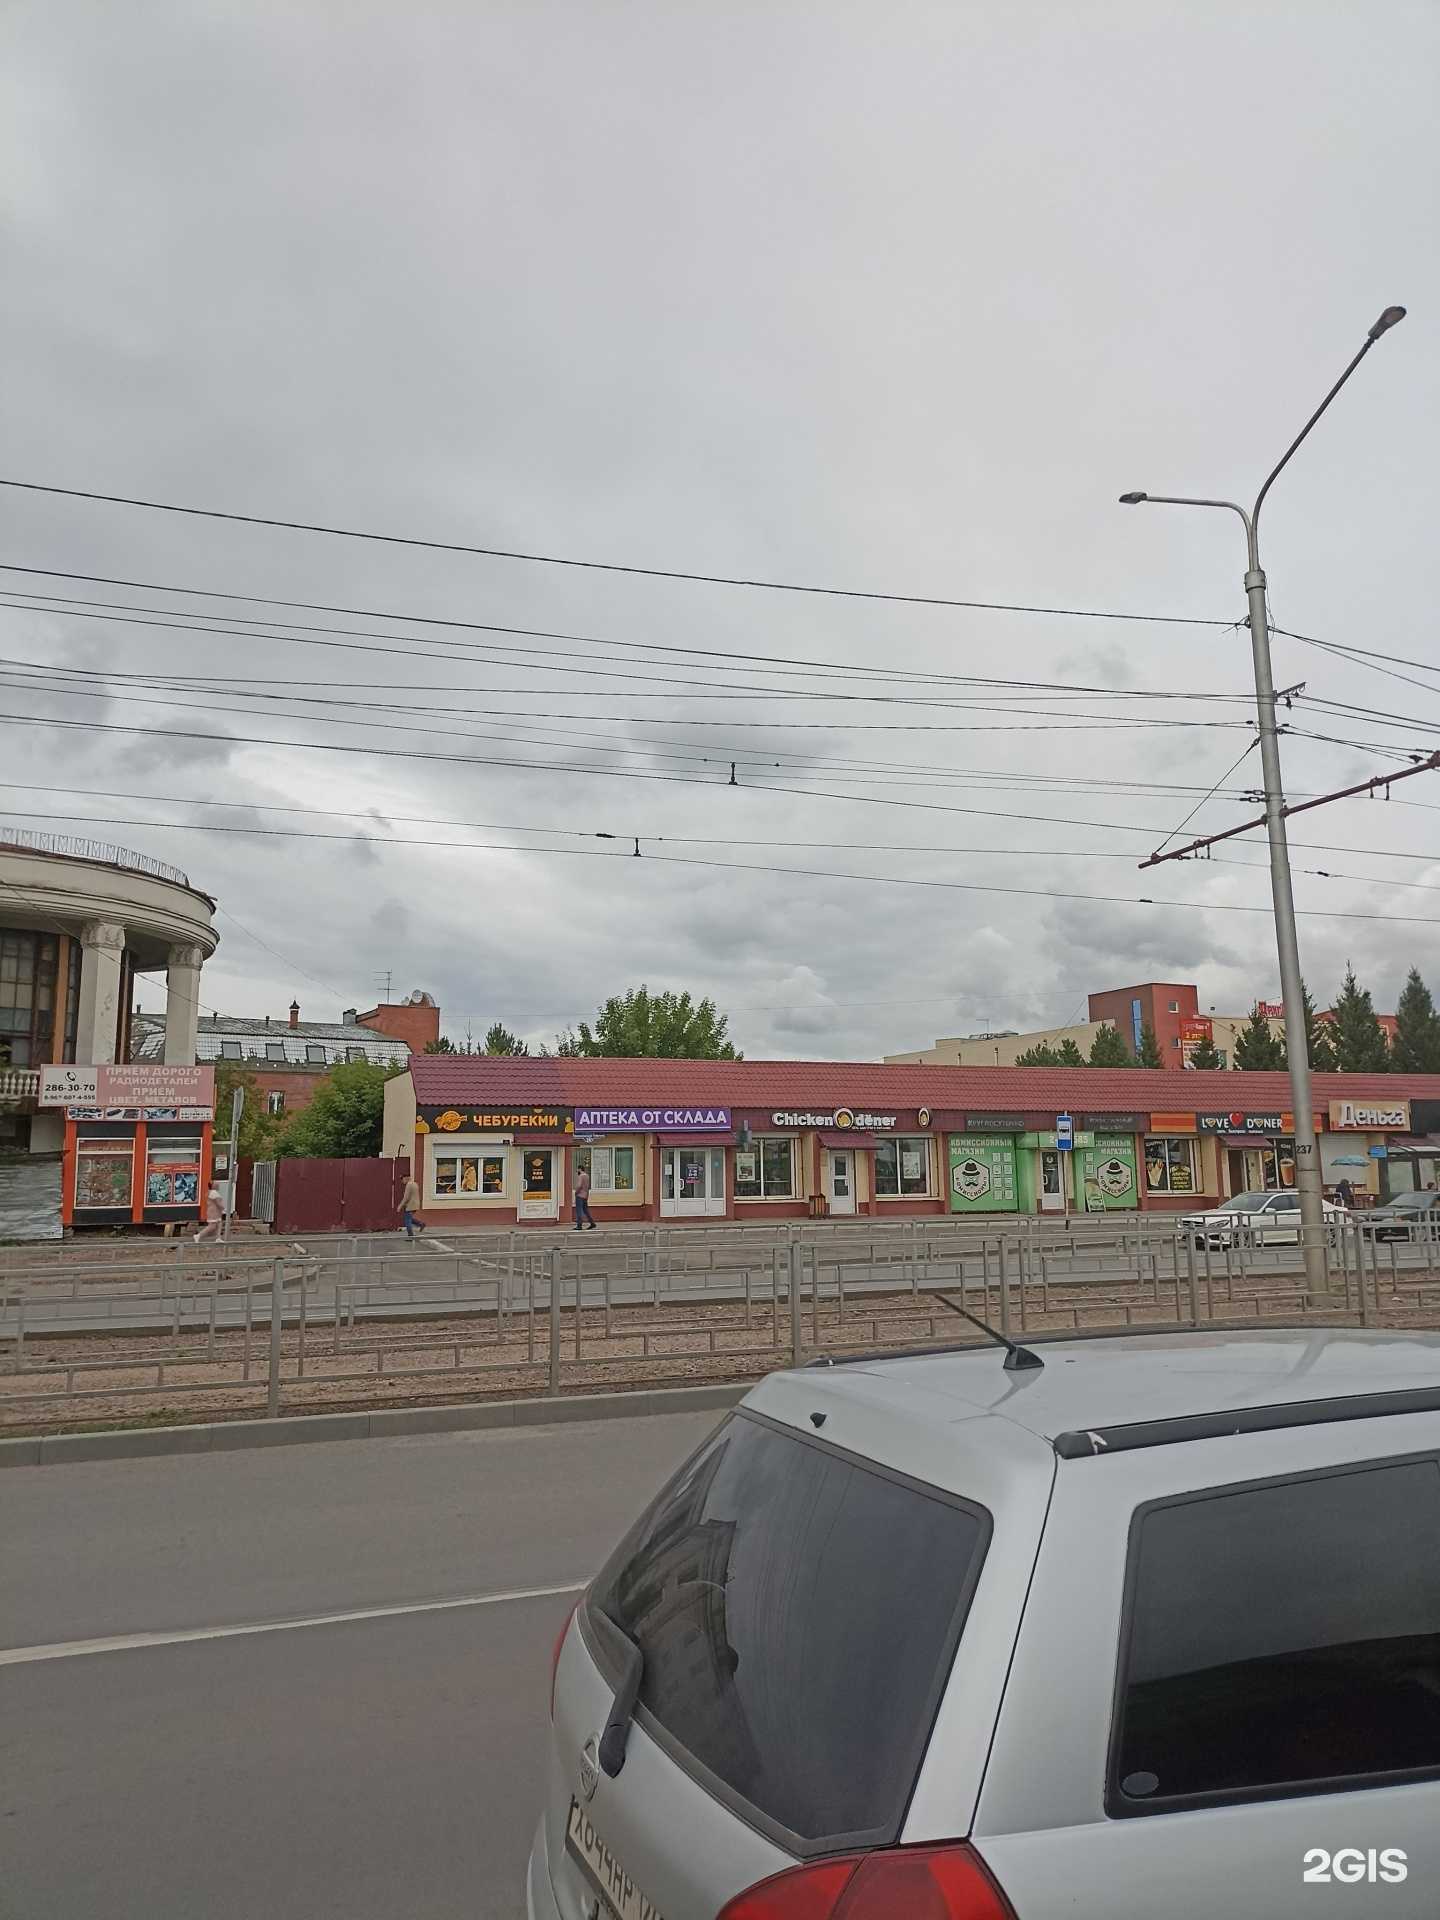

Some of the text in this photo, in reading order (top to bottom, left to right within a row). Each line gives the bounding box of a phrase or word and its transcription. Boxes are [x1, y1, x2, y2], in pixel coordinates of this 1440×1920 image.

[45, 1084, 95, 1092] 286-30-70
[473, 1115, 558, 1127] ЧЕБУРЕКМИ
[579, 1110, 727, 1125] АПТЕКА ОТ СКЛАДА
[772, 1112, 834, 1126] Chicken
[1296, 1144, 1312, 1154] 237
